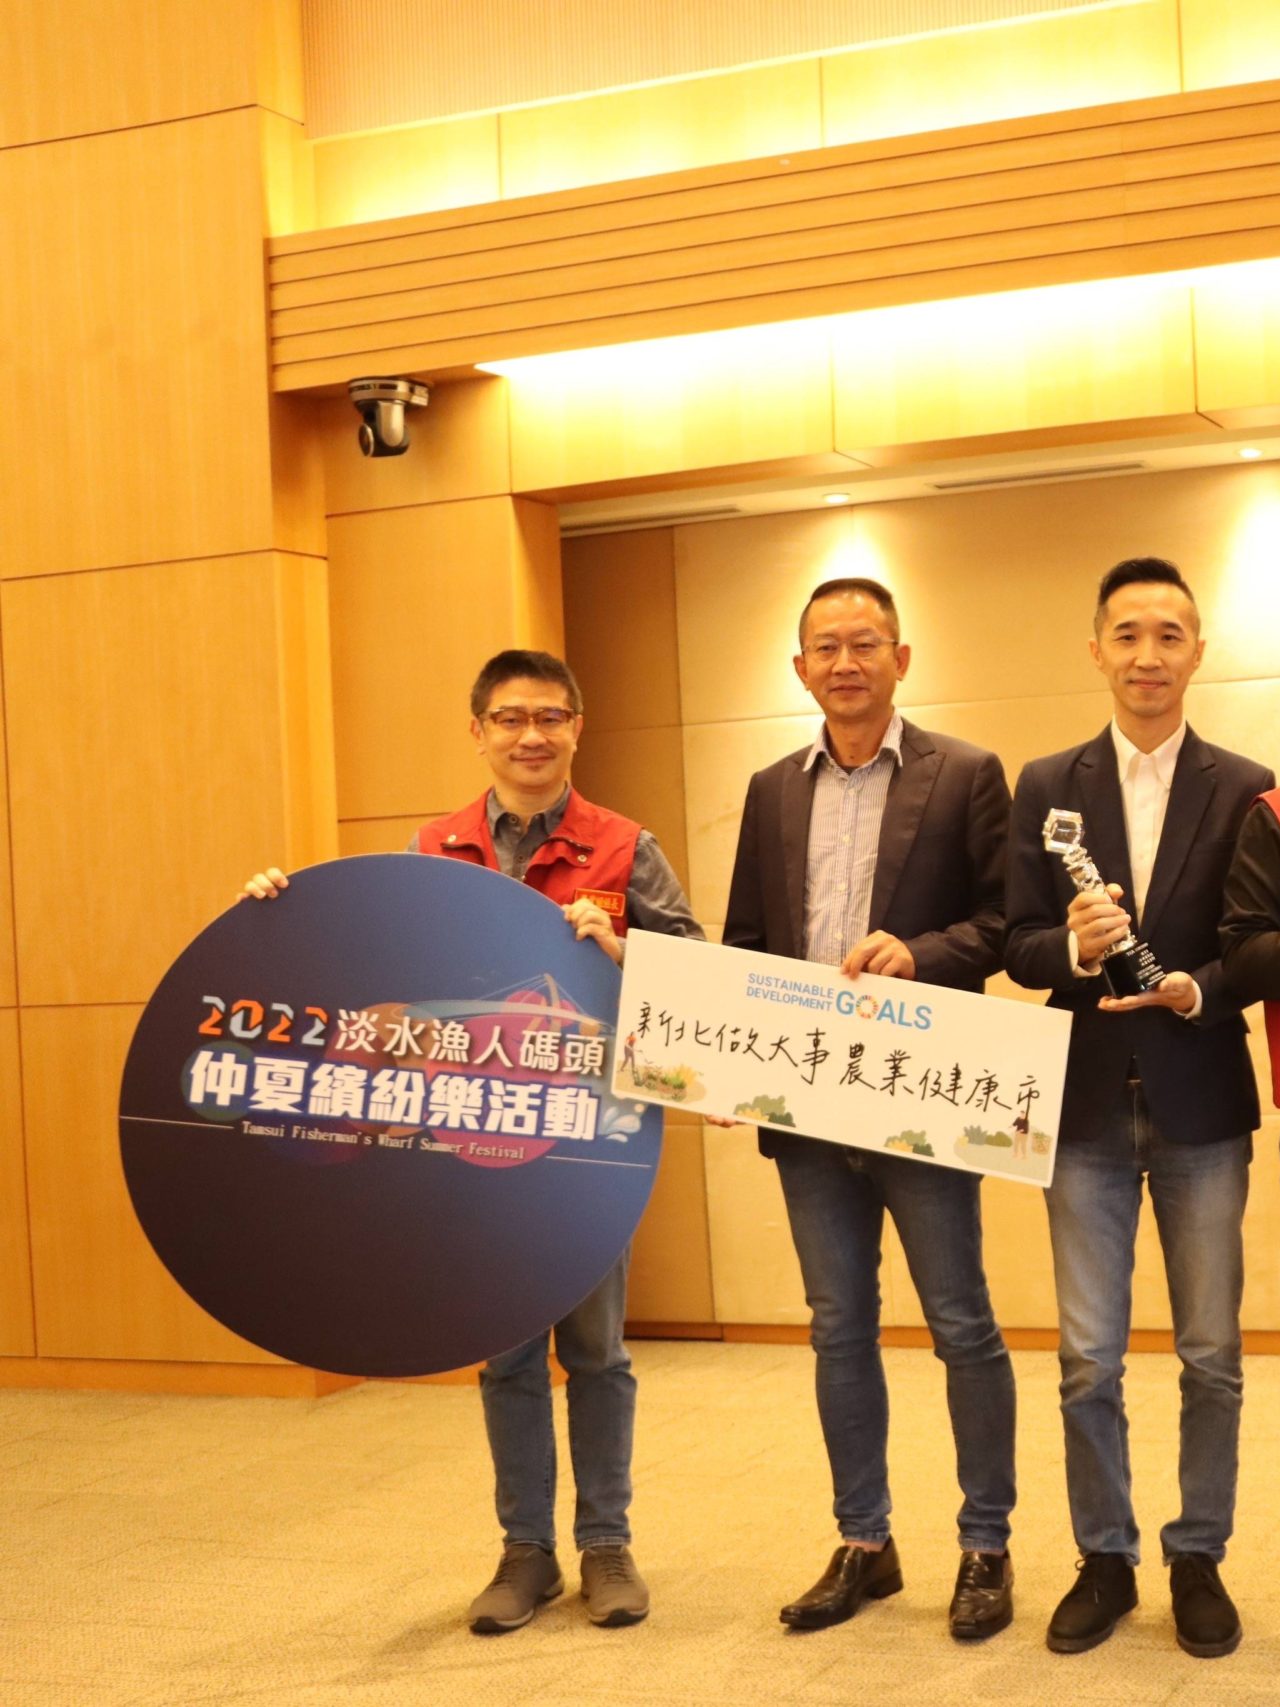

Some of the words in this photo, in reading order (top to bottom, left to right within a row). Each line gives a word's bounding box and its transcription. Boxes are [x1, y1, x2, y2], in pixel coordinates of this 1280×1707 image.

[748, 973, 835, 999] SUSTAINABLE
[746, 986, 833, 1012] DEVELOPMENT
[835, 990, 933, 1031] GOALS
[189, 1050, 599, 1141] 仲夏繽紛樂活動
[242, 1121, 285, 1138] Tamsui
[292, 1125, 372, 1145] Fisherman's
[378, 1134, 414, 1149] Wharf
[468, 1142, 525, 1160] Festival
